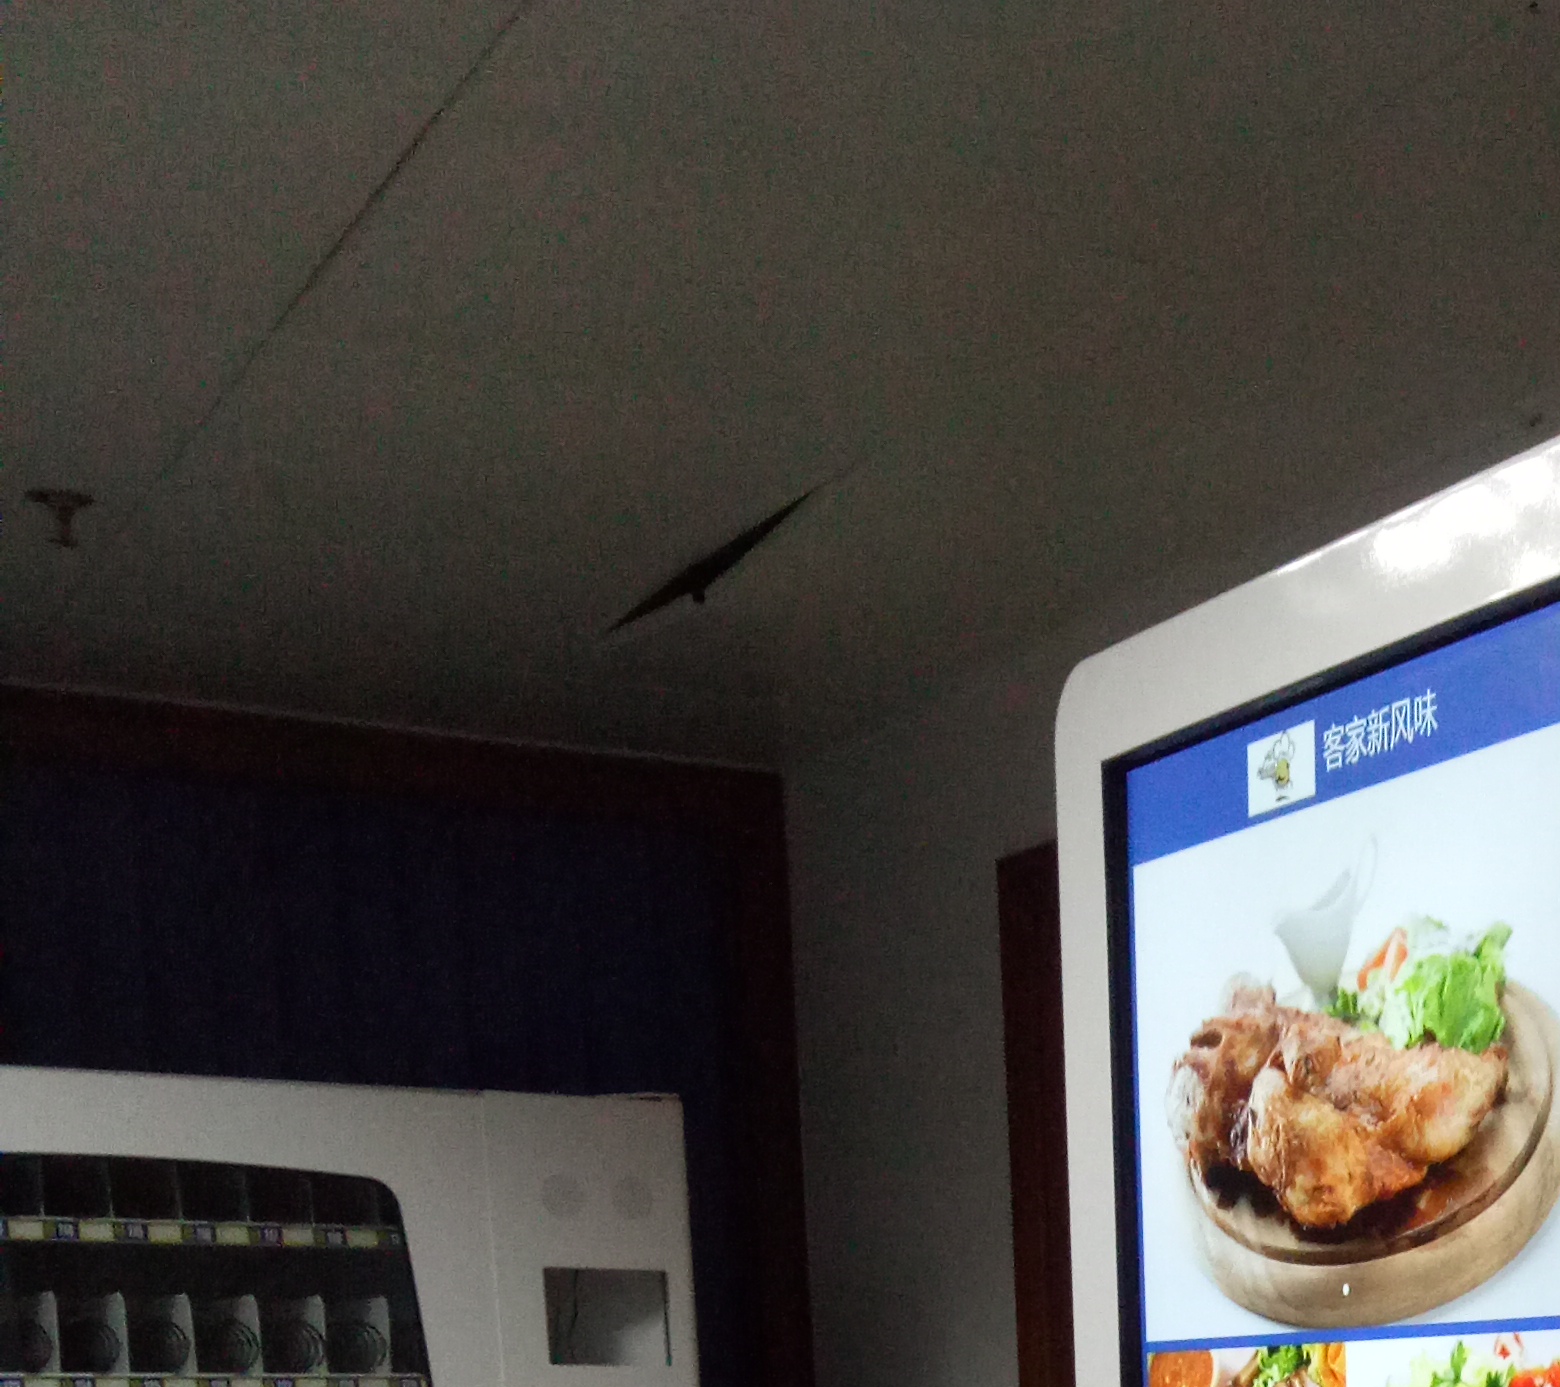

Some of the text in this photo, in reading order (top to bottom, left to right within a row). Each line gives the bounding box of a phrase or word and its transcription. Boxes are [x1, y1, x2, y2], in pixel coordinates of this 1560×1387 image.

[1322, 688, 1439, 773] 客家新风味
